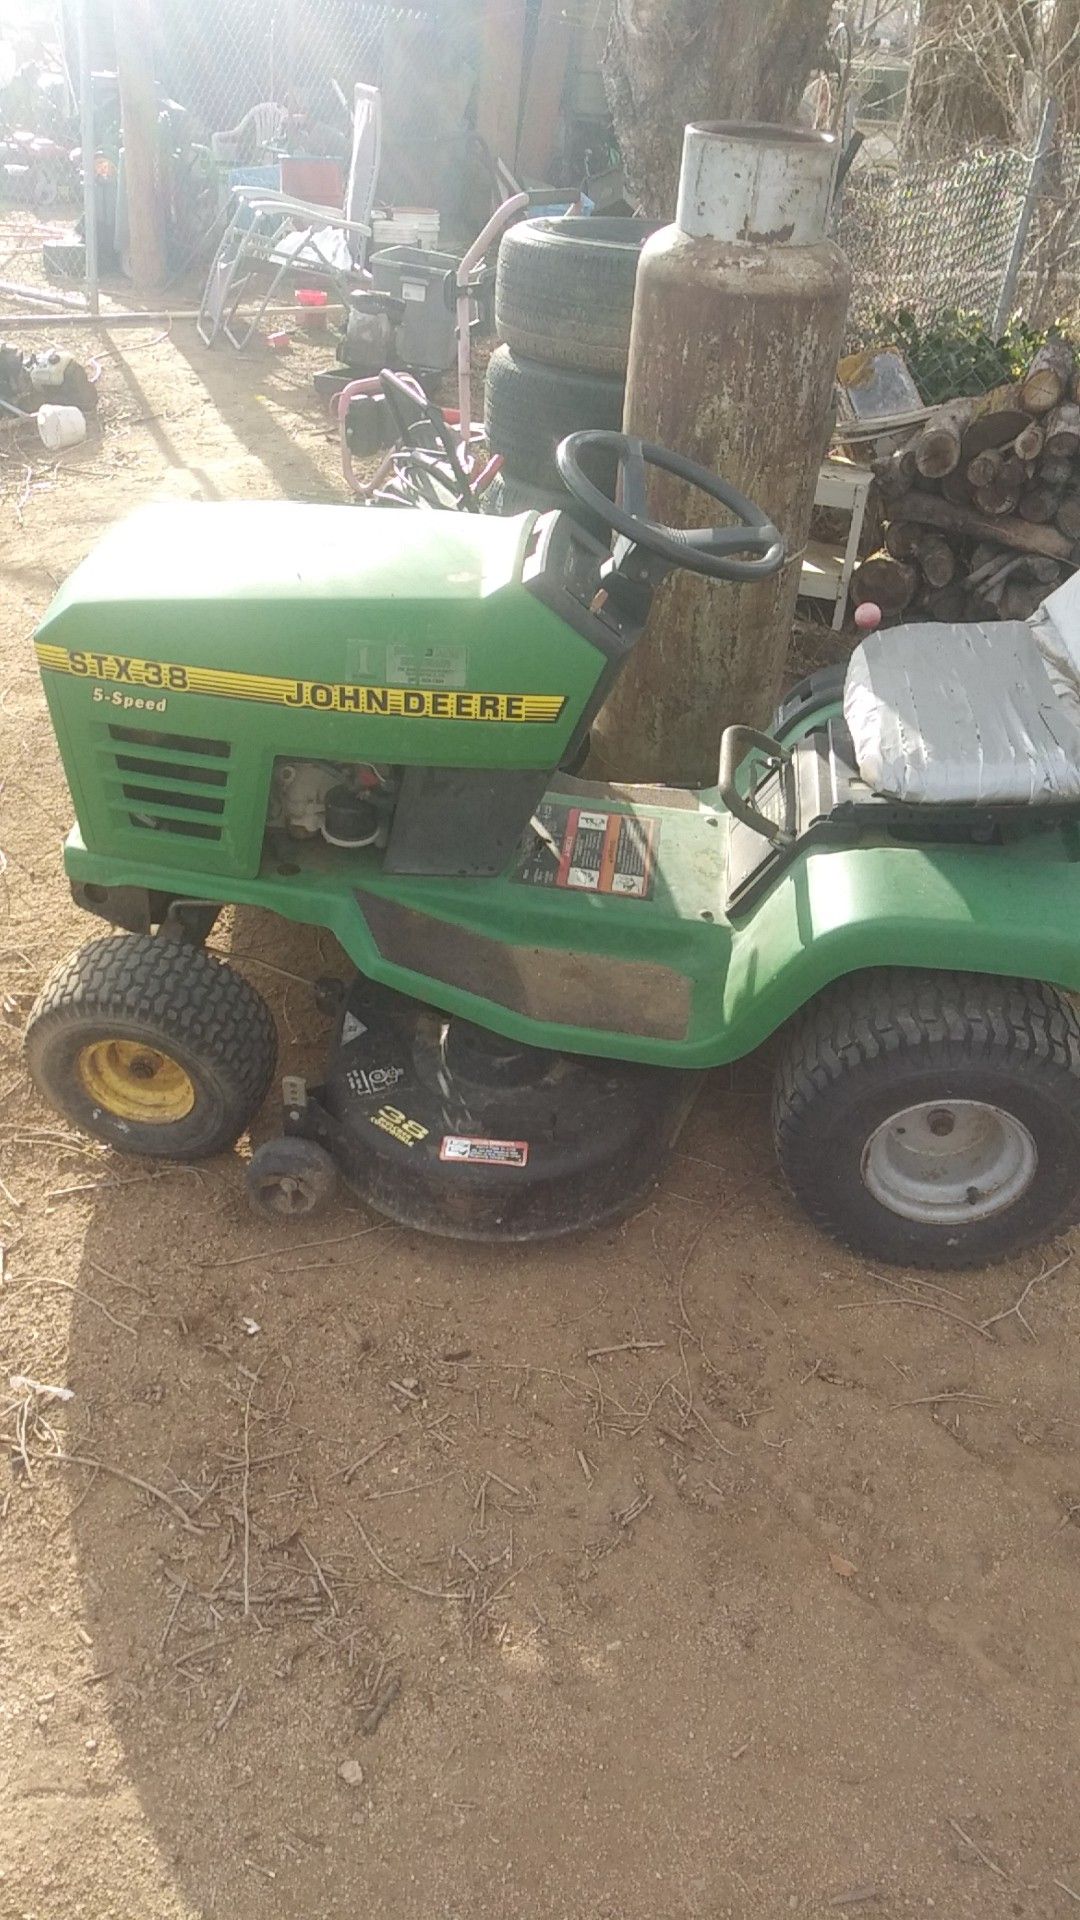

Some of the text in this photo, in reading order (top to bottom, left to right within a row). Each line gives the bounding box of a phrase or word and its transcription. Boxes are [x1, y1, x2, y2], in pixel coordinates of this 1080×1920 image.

[68, 651, 188, 689] STX 38
[93, 688, 167, 712] 5-Speed
[285, 683, 524, 719] JOHN DEERE
